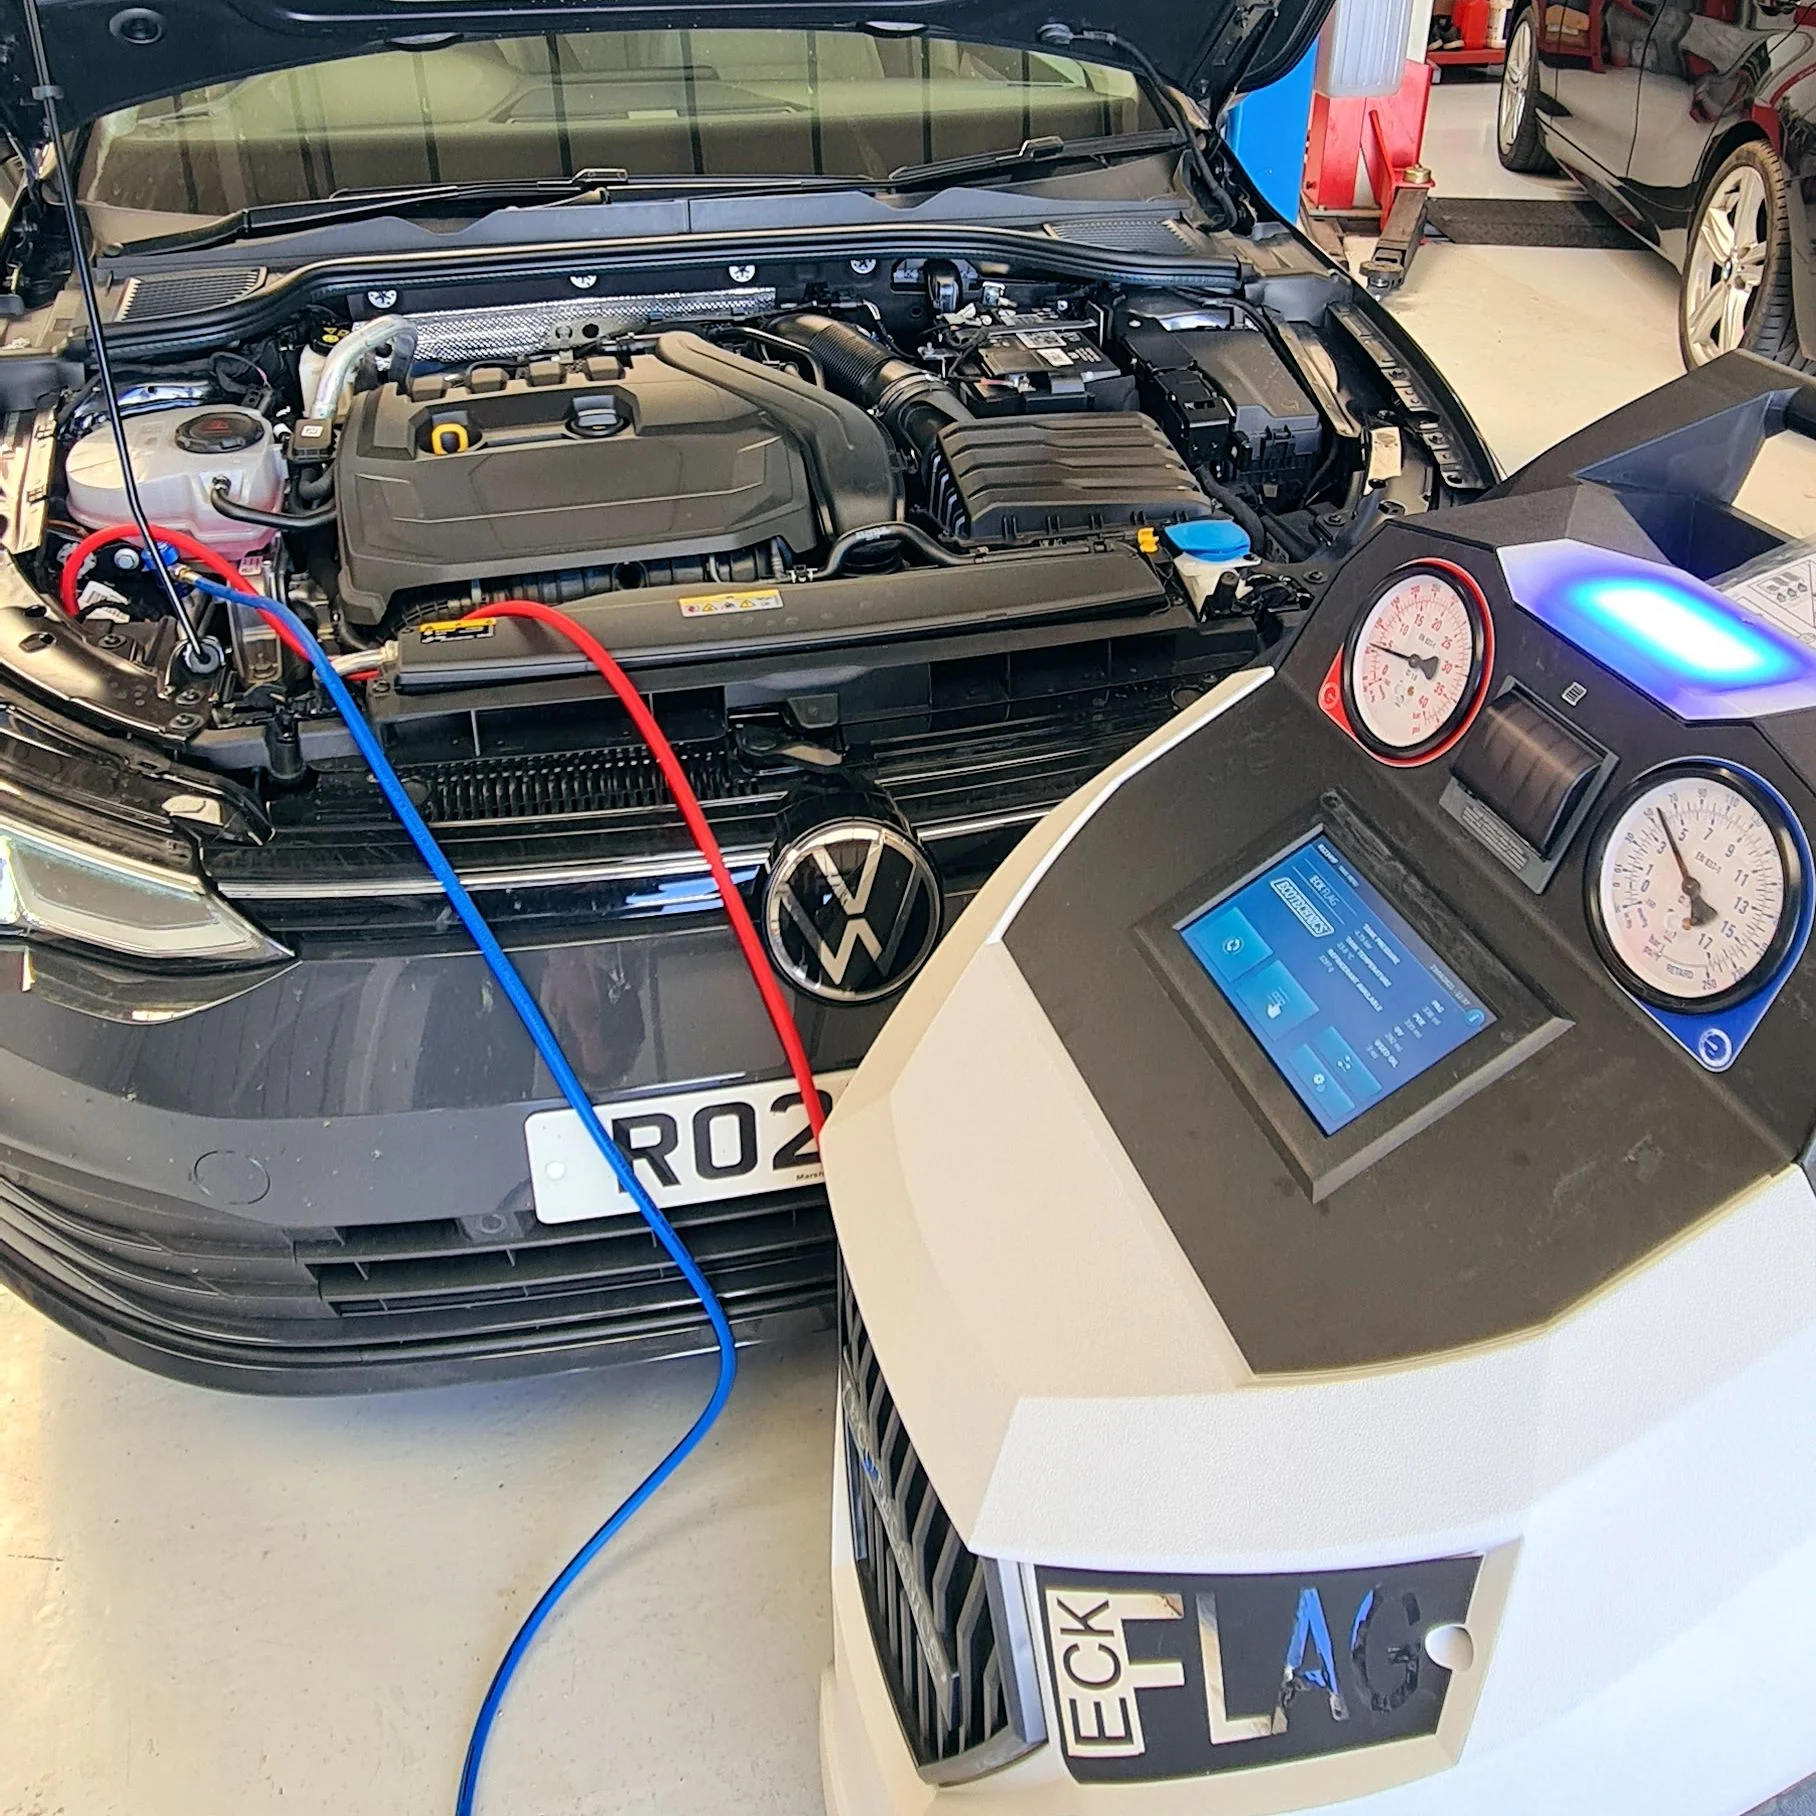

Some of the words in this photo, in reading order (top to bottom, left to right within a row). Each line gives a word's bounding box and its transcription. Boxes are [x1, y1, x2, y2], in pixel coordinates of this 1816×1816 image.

[1414, 613, 1424, 627] 15
[1431, 618, 1442, 632] 20
[1400, 623, 1410, 636] 10
[1441, 636, 1452, 650] 25
[1441, 660, 1452, 674] 30
[1433, 682, 1445, 696] 35
[1418, 695, 1429, 709] 40
[1678, 828, 1689, 842] 5
[1703, 827, 1714, 840] 7
[1657, 841, 1667, 854] 3
[1725, 843, 1735, 858] 9
[1734, 869, 1749, 887] 11
[1308, 874, 1326, 891] ECK
[1319, 886, 1340, 907] FLAG
[1640, 879, 1650, 892] 0
[1275, 878, 1329, 936] ECOTECHNICS
[1734, 896, 1750, 914] 13
[1721, 920, 1736, 938] 15
[1698, 933, 1713, 950] 17
[611, 1089, 833, 1193] RO2
[1056, 1595, 1135, 1757] ECK
